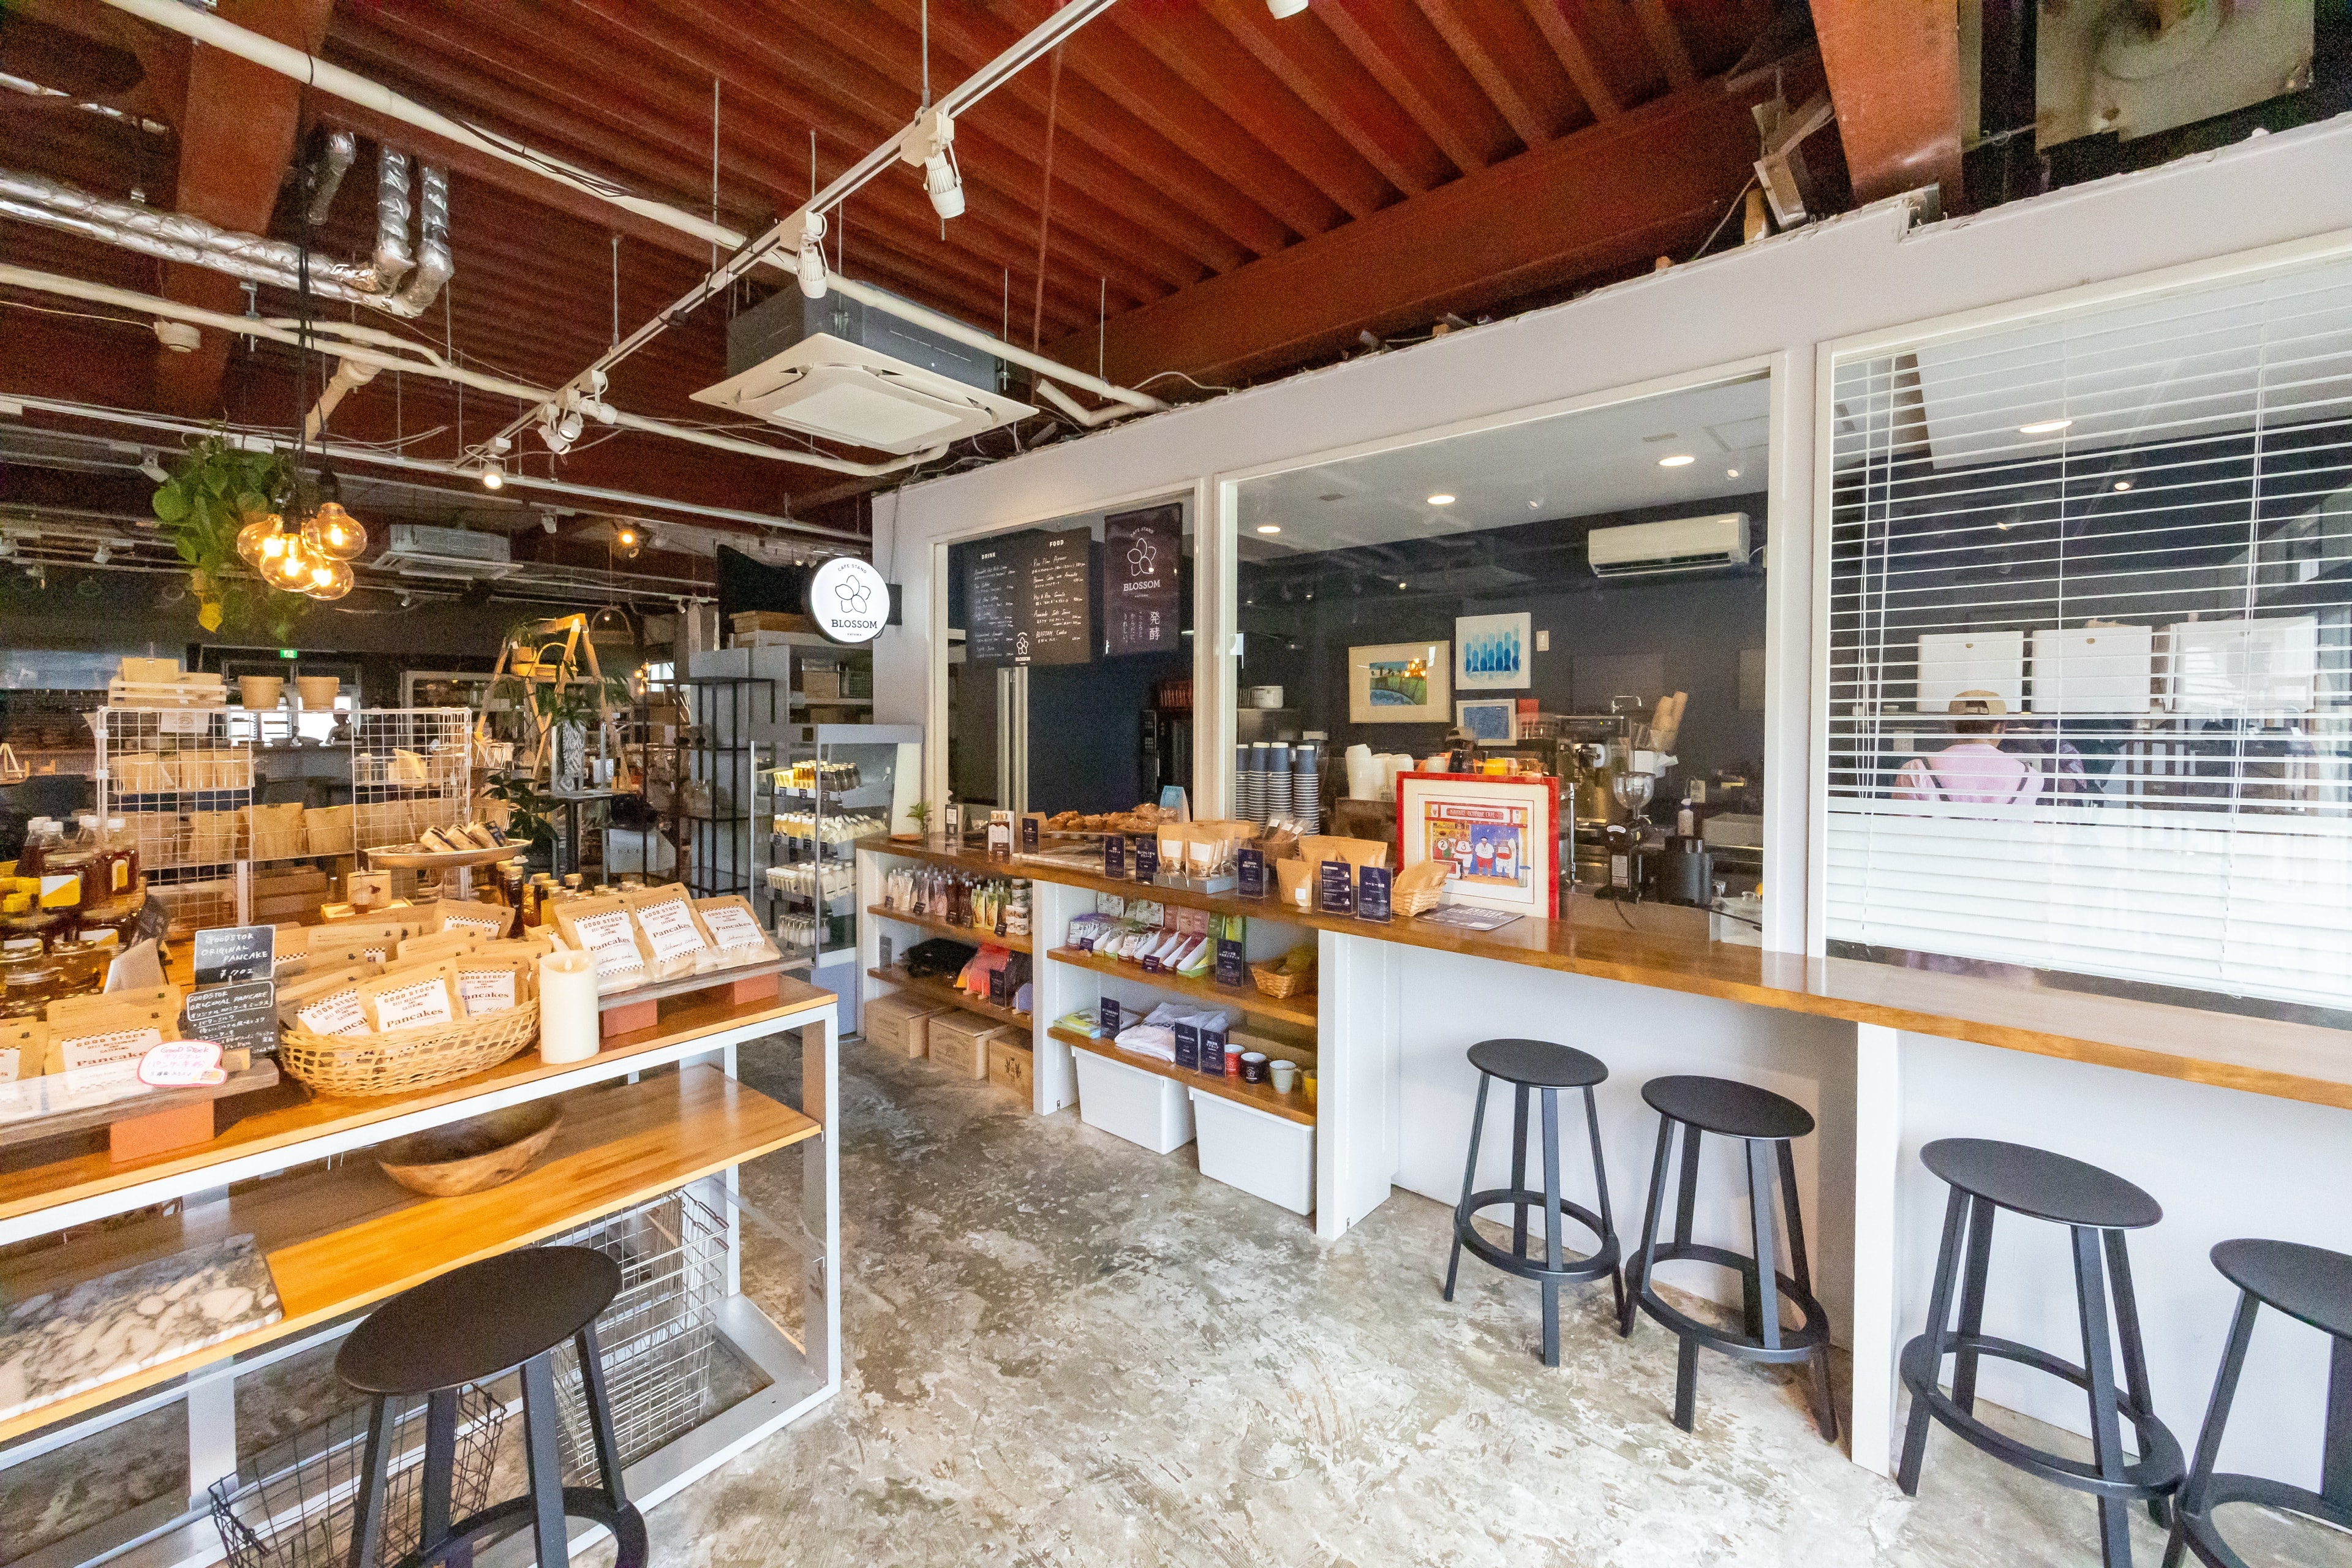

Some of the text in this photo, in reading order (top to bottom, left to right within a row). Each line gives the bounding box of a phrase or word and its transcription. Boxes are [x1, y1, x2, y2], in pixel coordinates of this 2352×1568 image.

[1130, 528, 1139, 538] CAFE
[852, 564, 867, 573] STAND
[1123, 579, 1161, 592] BLOSSOM
[831, 619, 878, 628] BLOSSOM
[1150, 611, 1161, 641] 発酵
[644, 910, 660, 919] GOOD
[584, 921, 600, 929] GOOD
[652, 924, 691, 938] Pancakes
[715, 922, 752, 931] Pancakes
[205, 932, 254, 944] GOODSTOK
[590, 937, 630, 951] Pancakes
[201, 945, 249, 956] ORIGINAL
[223, 951, 268, 963] PANCAKE
[188, 991, 228, 1003] GOODSTOK
[233, 992, 268, 1002] PANCAKE
[385, 985, 435, 1003] GOOD STOCK
[311, 1005, 333, 1019] GOOD
[387, 1009, 443, 1028] Pancakes
[76, 1033, 147, 1047] GOOD STOCK
[77, 1051, 148, 1066] Pancake
